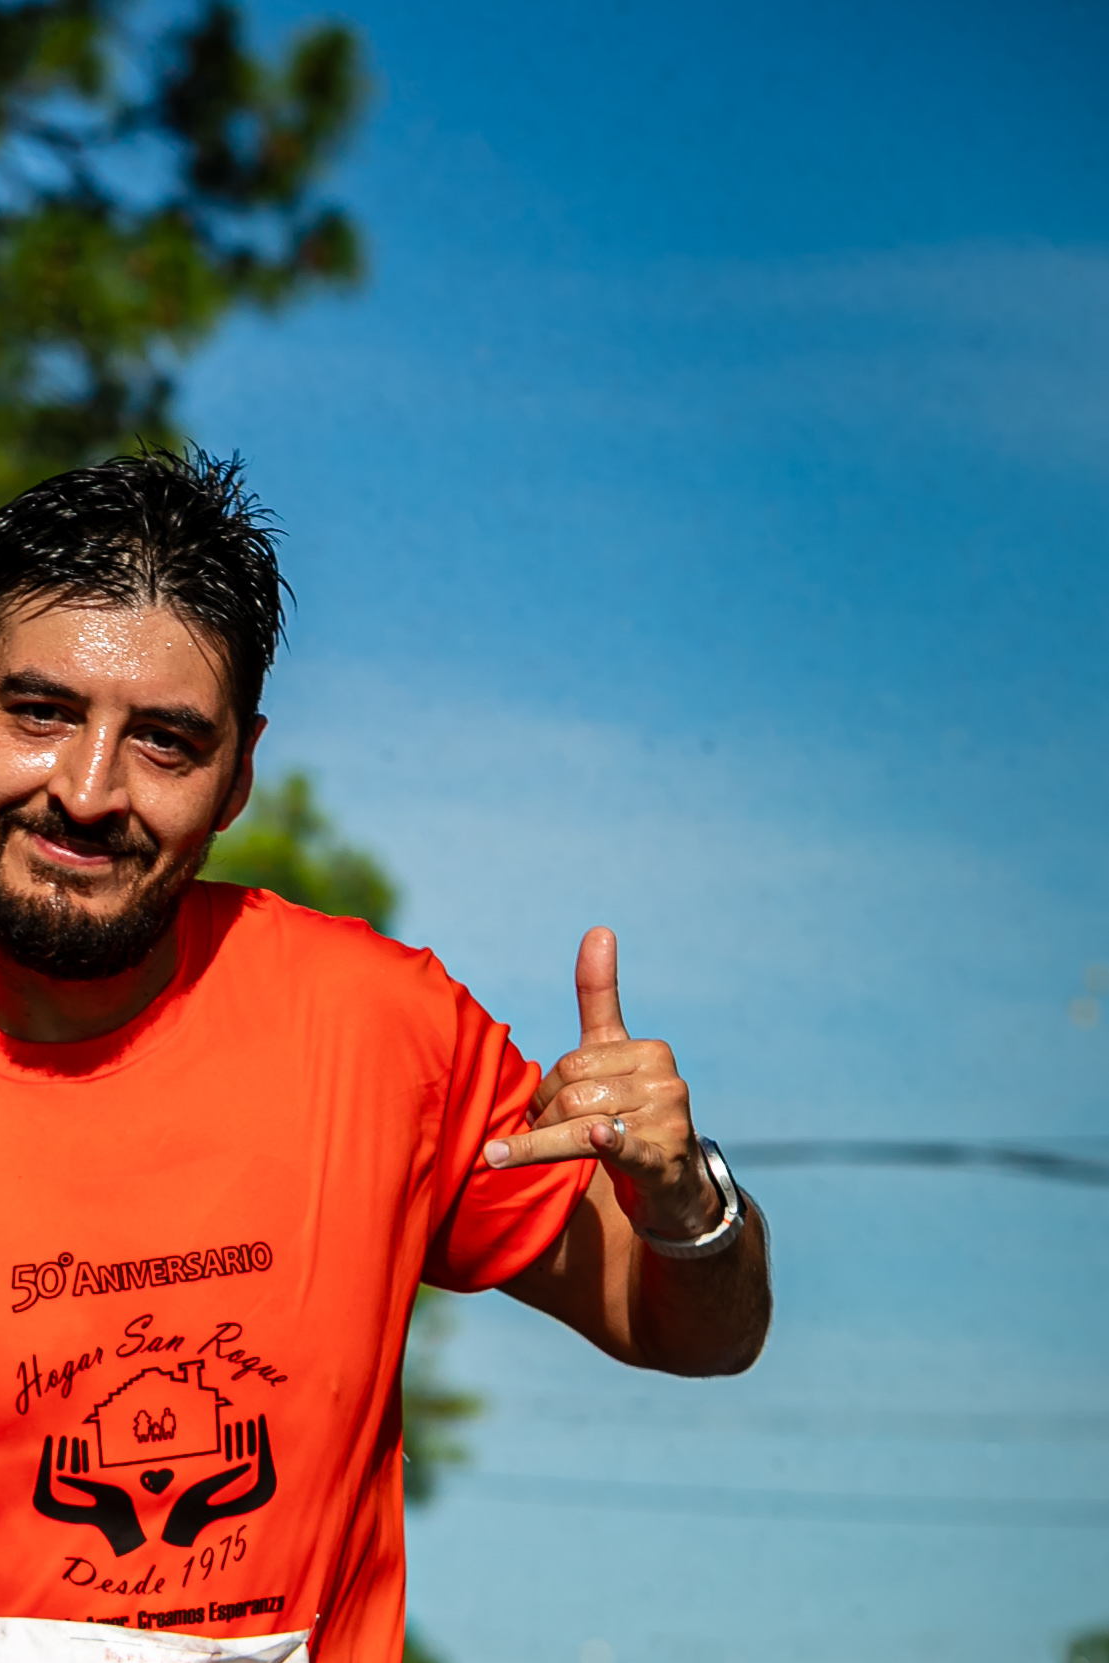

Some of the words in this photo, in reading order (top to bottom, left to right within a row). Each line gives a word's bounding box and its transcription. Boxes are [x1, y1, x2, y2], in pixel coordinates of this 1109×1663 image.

[73, 1242, 272, 1296] ANIVERSARIO
[16, 1347, 103, 1415] Hogar
[116, 1314, 185, 1357] San
[62, 1557, 166, 1594] Desde
[182, 1525, 247, 1587] 1975
[138, 1607, 205, 1629] Creamos
